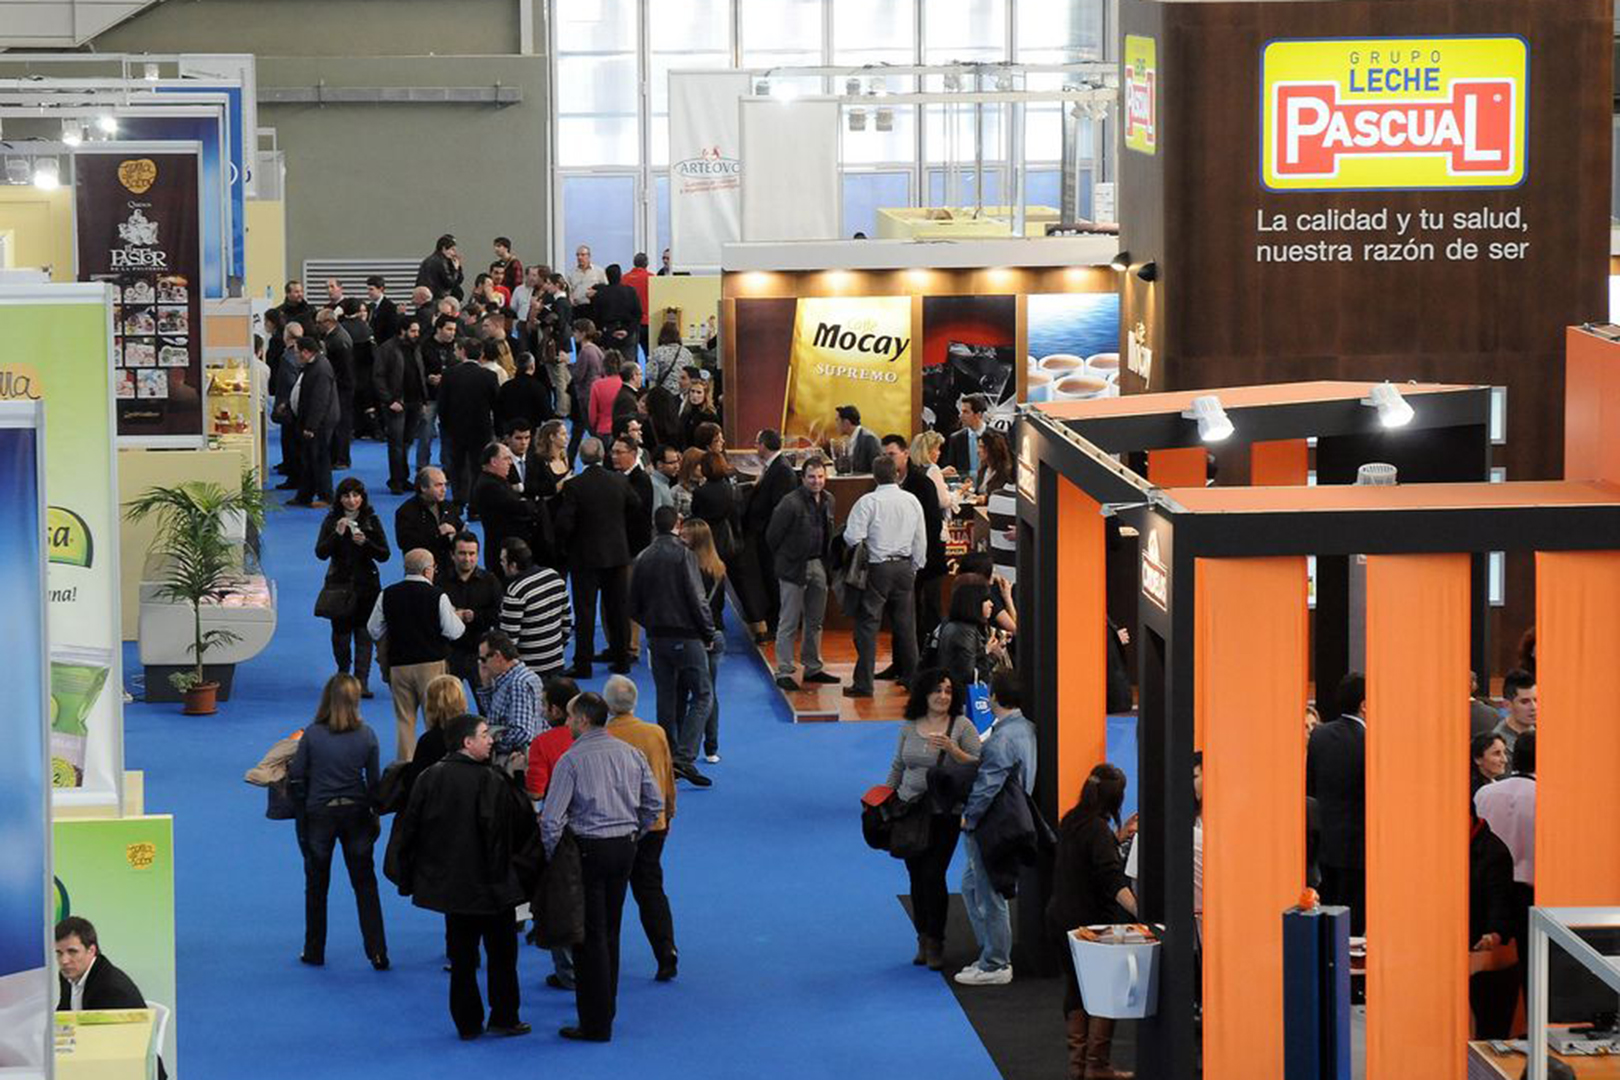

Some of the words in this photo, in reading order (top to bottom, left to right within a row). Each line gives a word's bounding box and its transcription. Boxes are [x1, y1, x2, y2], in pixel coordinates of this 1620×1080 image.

[1349, 50, 1441, 65] GRUPO
[1349, 67, 1440, 92] LECHE
[1256, 209, 1288, 231] La
[1296, 208, 1388, 231] calidad
[1396, 212, 1412, 235] y
[1419, 208, 1444, 230] tu
[1452, 207, 1529, 232] salud,
[109, 247, 167, 267] PASTOR
[1256, 241, 1353, 262] nuestra
[1363, 238, 1434, 261] razón
[1445, 238, 1479, 260] de
[1488, 241, 1530, 259] ser
[812, 322, 910, 362] Mocay
[814, 362, 899, 384] SUPREMO
